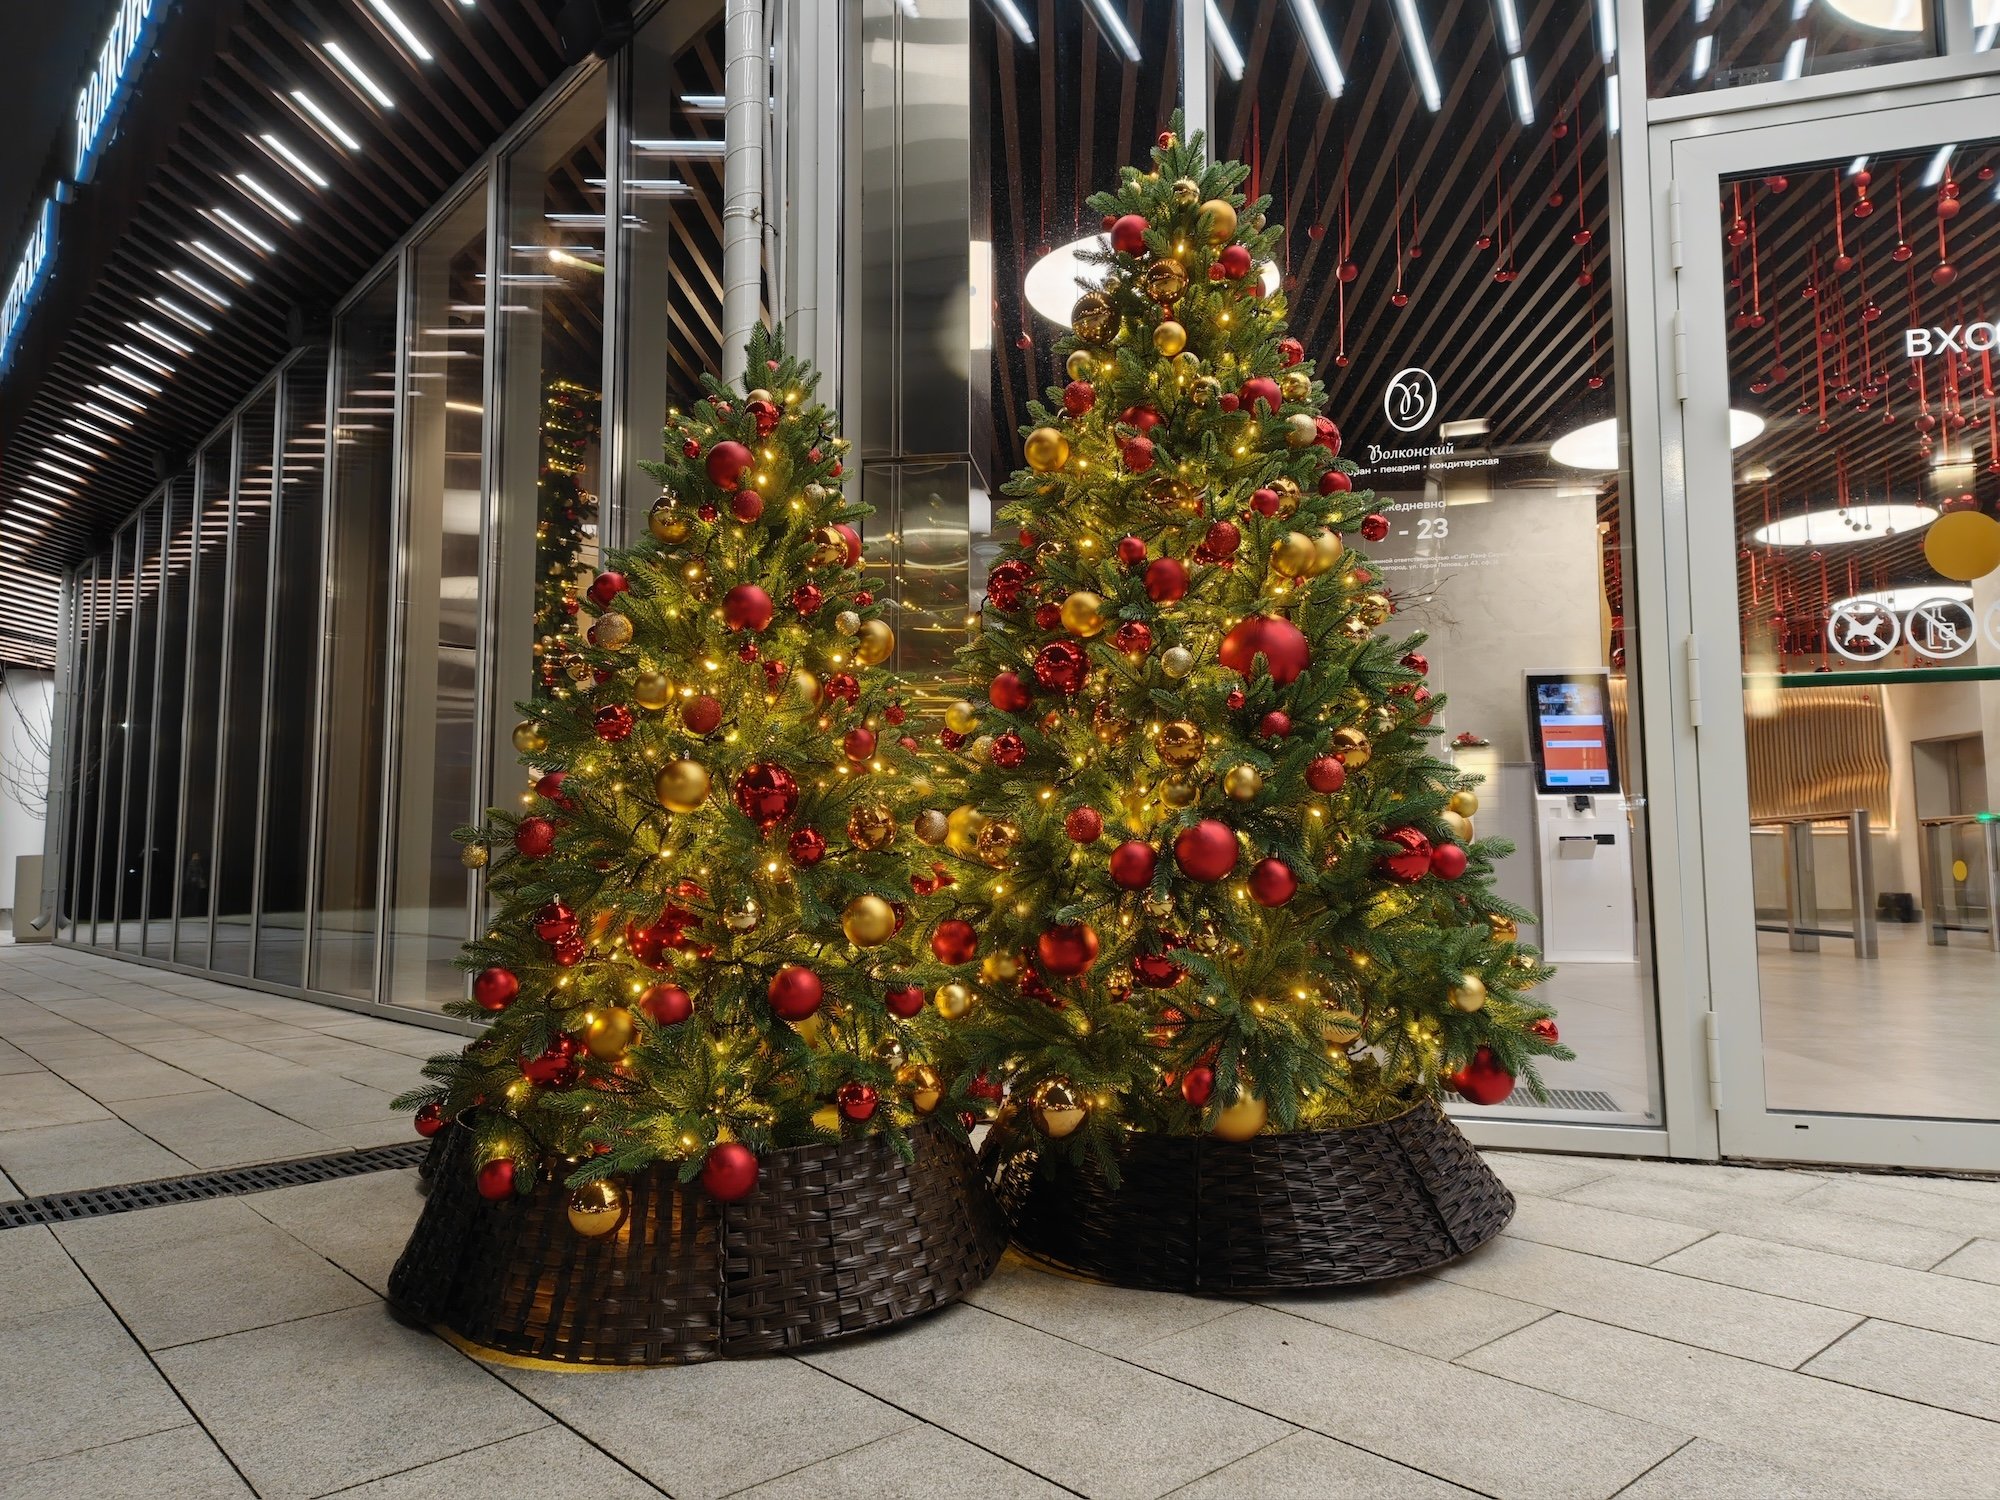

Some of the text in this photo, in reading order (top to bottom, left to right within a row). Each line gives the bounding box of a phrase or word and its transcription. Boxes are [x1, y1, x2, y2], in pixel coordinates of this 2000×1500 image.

[1906, 322, 1999, 357] ВХО
[1367, 442, 1454, 464] Волконский
[1380, 464, 1420, 474] пекарня
[1429, 458, 1499, 470] кондитерская
[1416, 517, 1449, 540] 23
